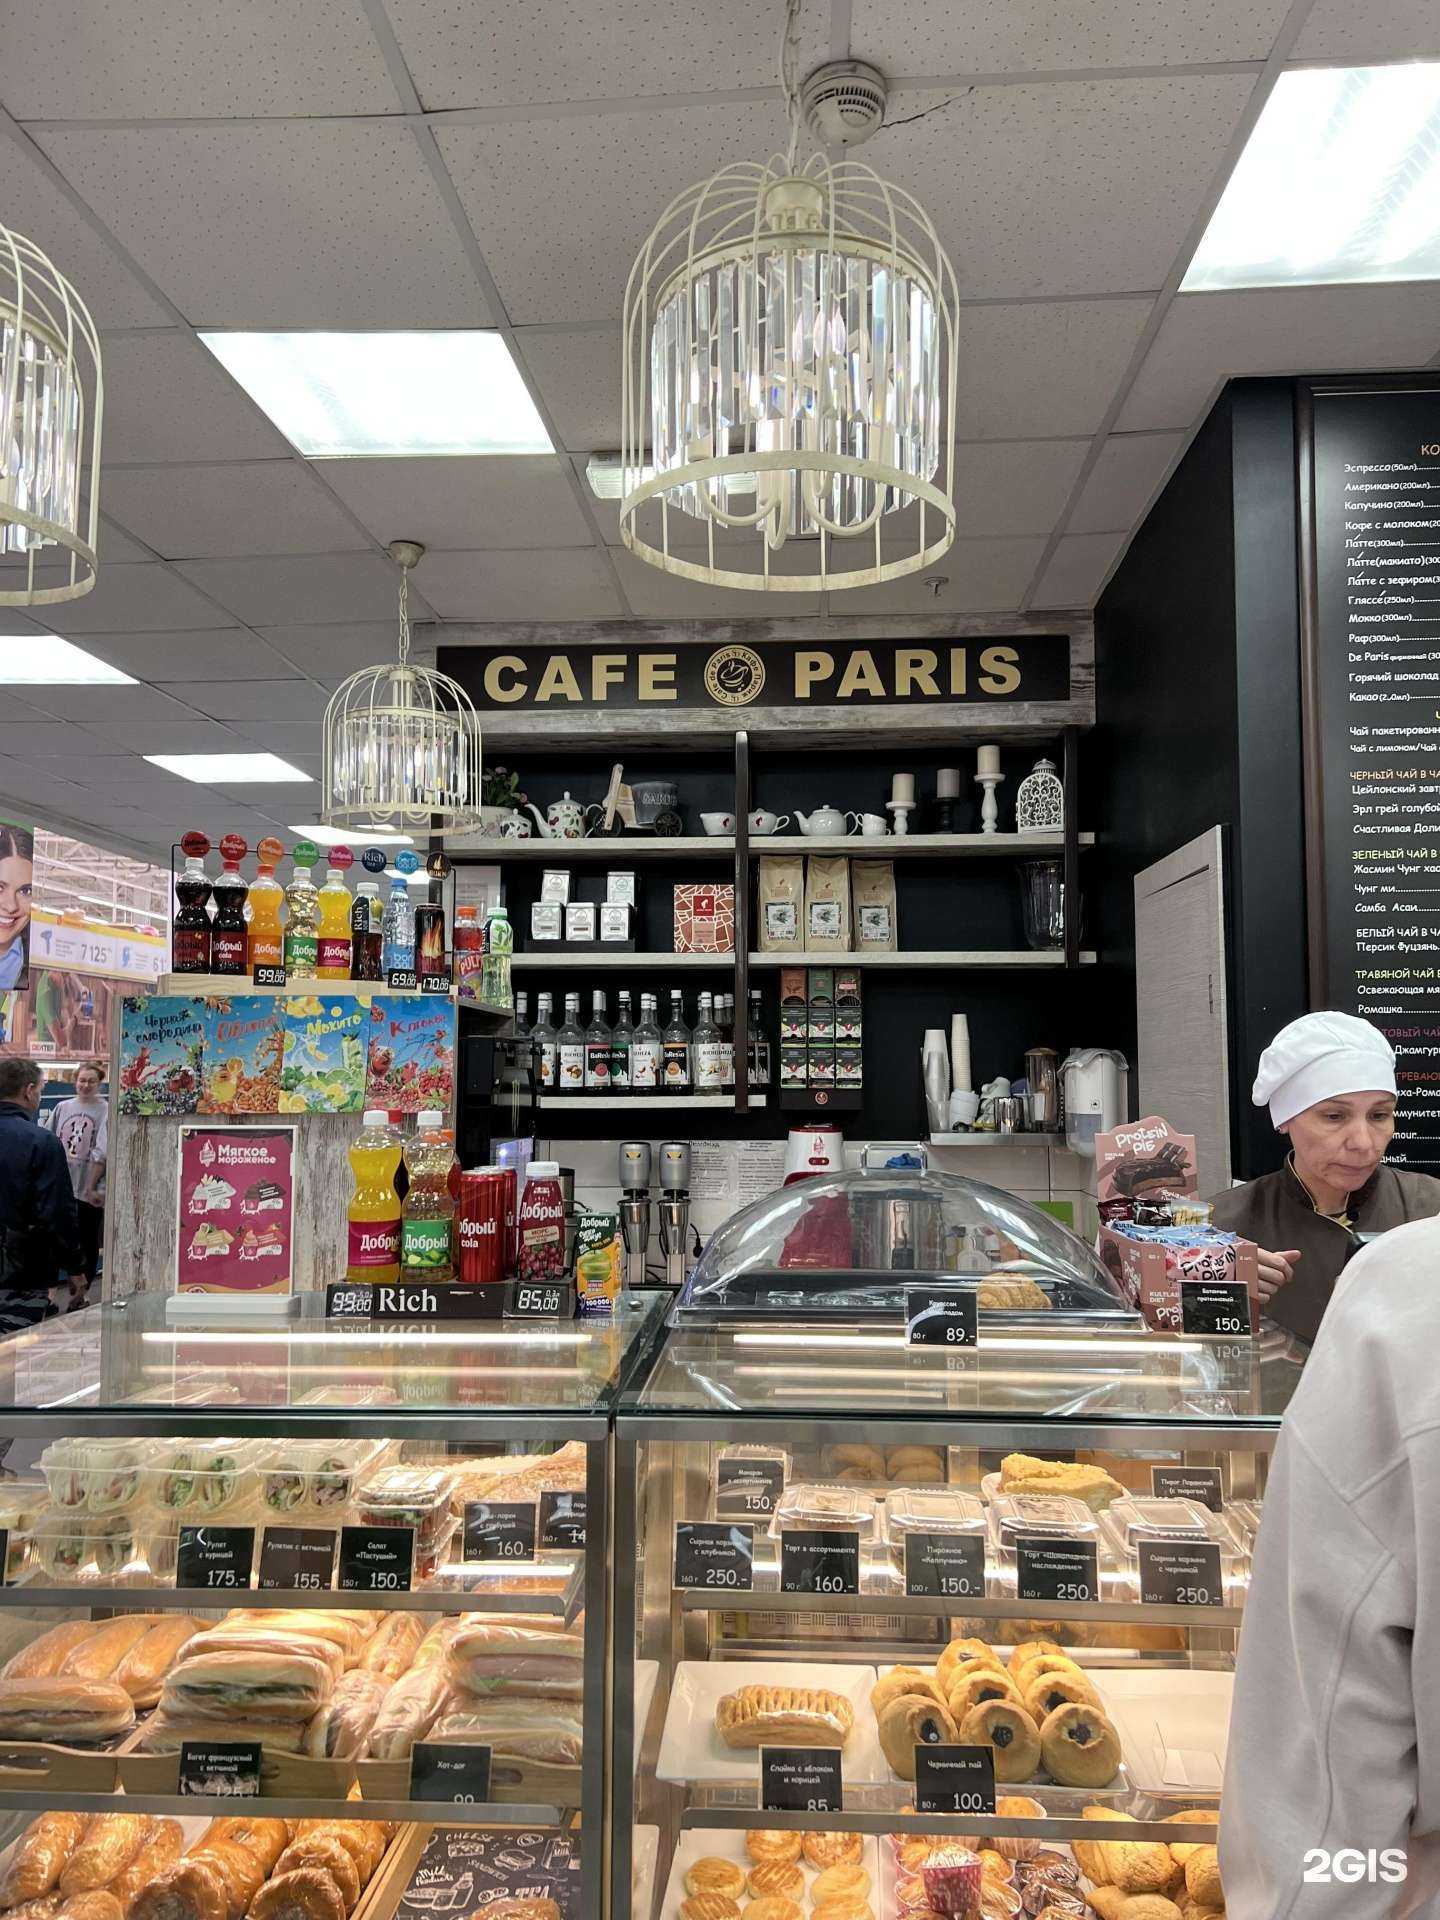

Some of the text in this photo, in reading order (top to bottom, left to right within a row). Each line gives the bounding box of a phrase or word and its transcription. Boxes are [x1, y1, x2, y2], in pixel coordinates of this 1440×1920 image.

[1345, 521, 1372, 532] Кофе
[1349, 652, 1389, 662] De Paris
[483, 654, 678, 702] CAFE
[794, 646, 1022, 699] PARIS
[1349, 672, 1391, 684] Горячий
[1350, 727, 1368, 735] Чай
[1350, 744, 1366, 752] Чай
[1350, 769, 1393, 779] ЧЕРНЫЙ
[1397, 769, 1417, 778] ЧАЙ
[1421, 770, 1426, 778] В
[1352, 784, 1415, 795] Цейлонский
[1353, 805, 1372, 815] Эрл
[1376, 804, 1398, 815] грей
[1353, 825, 1411, 833] Счастливая
[365, 852, 384, 862] Rich
[1352, 848, 1437, 859] ЗЕЛЕНЫЙ ЧАЙ В
[1354, 864, 1421, 875] Жасмин Чунг
[1355, 884, 1378, 895] Чунг
[1355, 903, 1386, 912] Самба
[354, 906, 363, 930] Rich
[1357, 926, 1394, 937] БЕЛЫЙ
[1397, 926, 1418, 937] ЧАЙ
[1422, 928, 1427, 937] В
[1356, 942, 1395, 953] Персик
[1355, 968, 1434, 979] ТРАВЯНОЙ ЧАЙ
[1357, 985, 1424, 995] Освежающая
[1358, 1004, 1403, 1014] Ромашка
[1383, 1026, 1421, 1037] ТОВЫЙ
[1393, 1110, 1440, 1120] ммунитет
[1393, 1132, 1417, 1140] mour
[218, 1144, 268, 1157] Мягкое
[218, 1155, 277, 1165] мороженое
[1380, 1153, 1407, 1163] дный
[521, 1201, 562, 1221] Добрый
[460, 1218, 496, 1236] обрый
[580, 1217, 610, 1229] Добрый
[405, 1234, 449, 1251] Добрый
[461, 1239, 479, 1249] cola
[379, 1287, 437, 1312] Rich
[518, 1290, 559, 1311] 85,00
[1215, 1317, 1250, 1332] 150.-
[367, 1542, 387, 1550] Салат
[208, 1569, 246, 1587] 175.-
[370, 1572, 408, 1589] 150.-
[706, 1569, 748, 1586] 250.-
[815, 1576, 854, 1593] 160.-
[941, 1577, 981, 1595] 150.-
[1176, 1587, 1220, 1604] 250.-
[953, 1792, 993, 1810] 100.-
